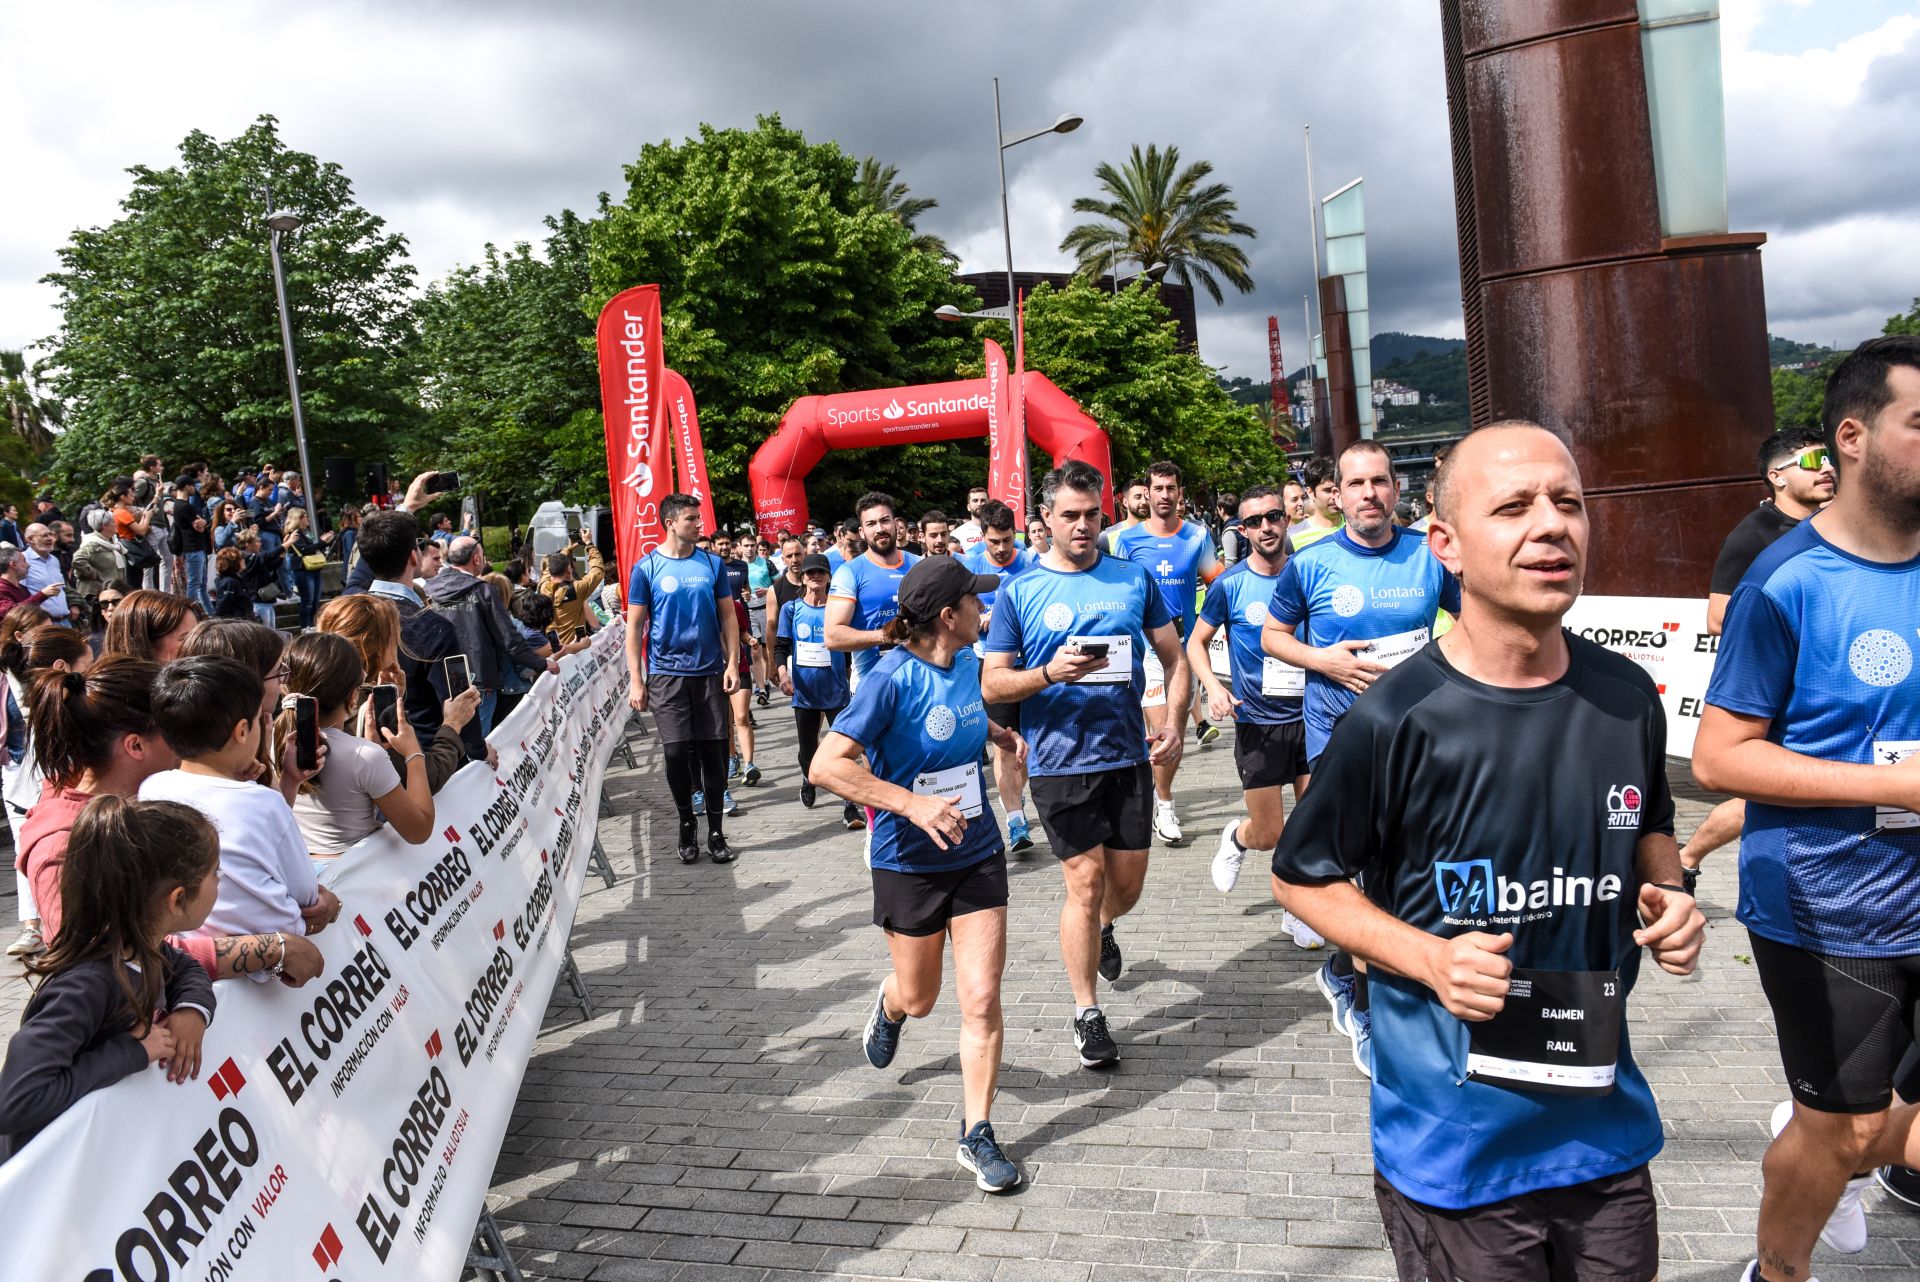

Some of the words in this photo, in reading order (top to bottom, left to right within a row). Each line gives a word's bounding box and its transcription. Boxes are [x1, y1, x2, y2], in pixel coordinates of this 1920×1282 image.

[620, 310, 651, 458] Santander
[827, 407, 880, 428] Sports
[907, 394, 989, 417] Santande
[882, 423, 939, 434] sportssantander.es
[759, 498, 782, 508] Sports
[759, 508, 796, 520] Santander
[634, 502, 660, 556] orts
[1161, 578, 1186, 586] FARMA
[1370, 586, 1425, 599] Lontana
[878, 608, 894, 617] FAES
[1075, 600, 1126, 613] Lontana
[1372, 601, 1400, 609] Group
[1580, 627, 1667, 648] CORREO
[1678, 697, 1702, 718] EL
[961, 716, 980, 727] Group
[513, 754, 538, 793] CORREO
[965, 768, 975, 777] 665
[469, 823, 495, 857] EL
[482, 789, 519, 841] CORREO
[384, 907, 420, 951] EL
[405, 846, 472, 926] CORREO
[513, 914, 531, 952] EL
[526, 867, 553, 932] CORREO
[430, 909, 463, 952] INFORMACIÓN
[457, 896, 471, 915] CON
[1442, 915, 1474, 926] Almacén
[1476, 918, 1487, 927] de
[1489, 915, 1521, 925] Material
[465, 945, 513, 1036] CORREO
[1603, 982, 1615, 997] 23
[265, 1037, 319, 1107] EL
[300, 941, 391, 1061] CORREO
[1541, 1008, 1584, 1021] BAIMEN
[330, 1029, 380, 1098] INFORMACIÓN
[376, 1007, 394, 1033] CON
[390, 984, 410, 1014] VALOR
[454, 1017, 478, 1068] EL
[1546, 1040, 1577, 1053] RAUL
[355, 1192, 401, 1265] EL
[383, 1065, 451, 1208] CORREO
[413, 1164, 447, 1244] INFORMAZIO
[442, 1108, 470, 1167] BALIOTSUA
[82, 1107, 259, 1282] ORREO
[227, 1214, 256, 1260] CON
[251, 1164, 289, 1219] VALOR
